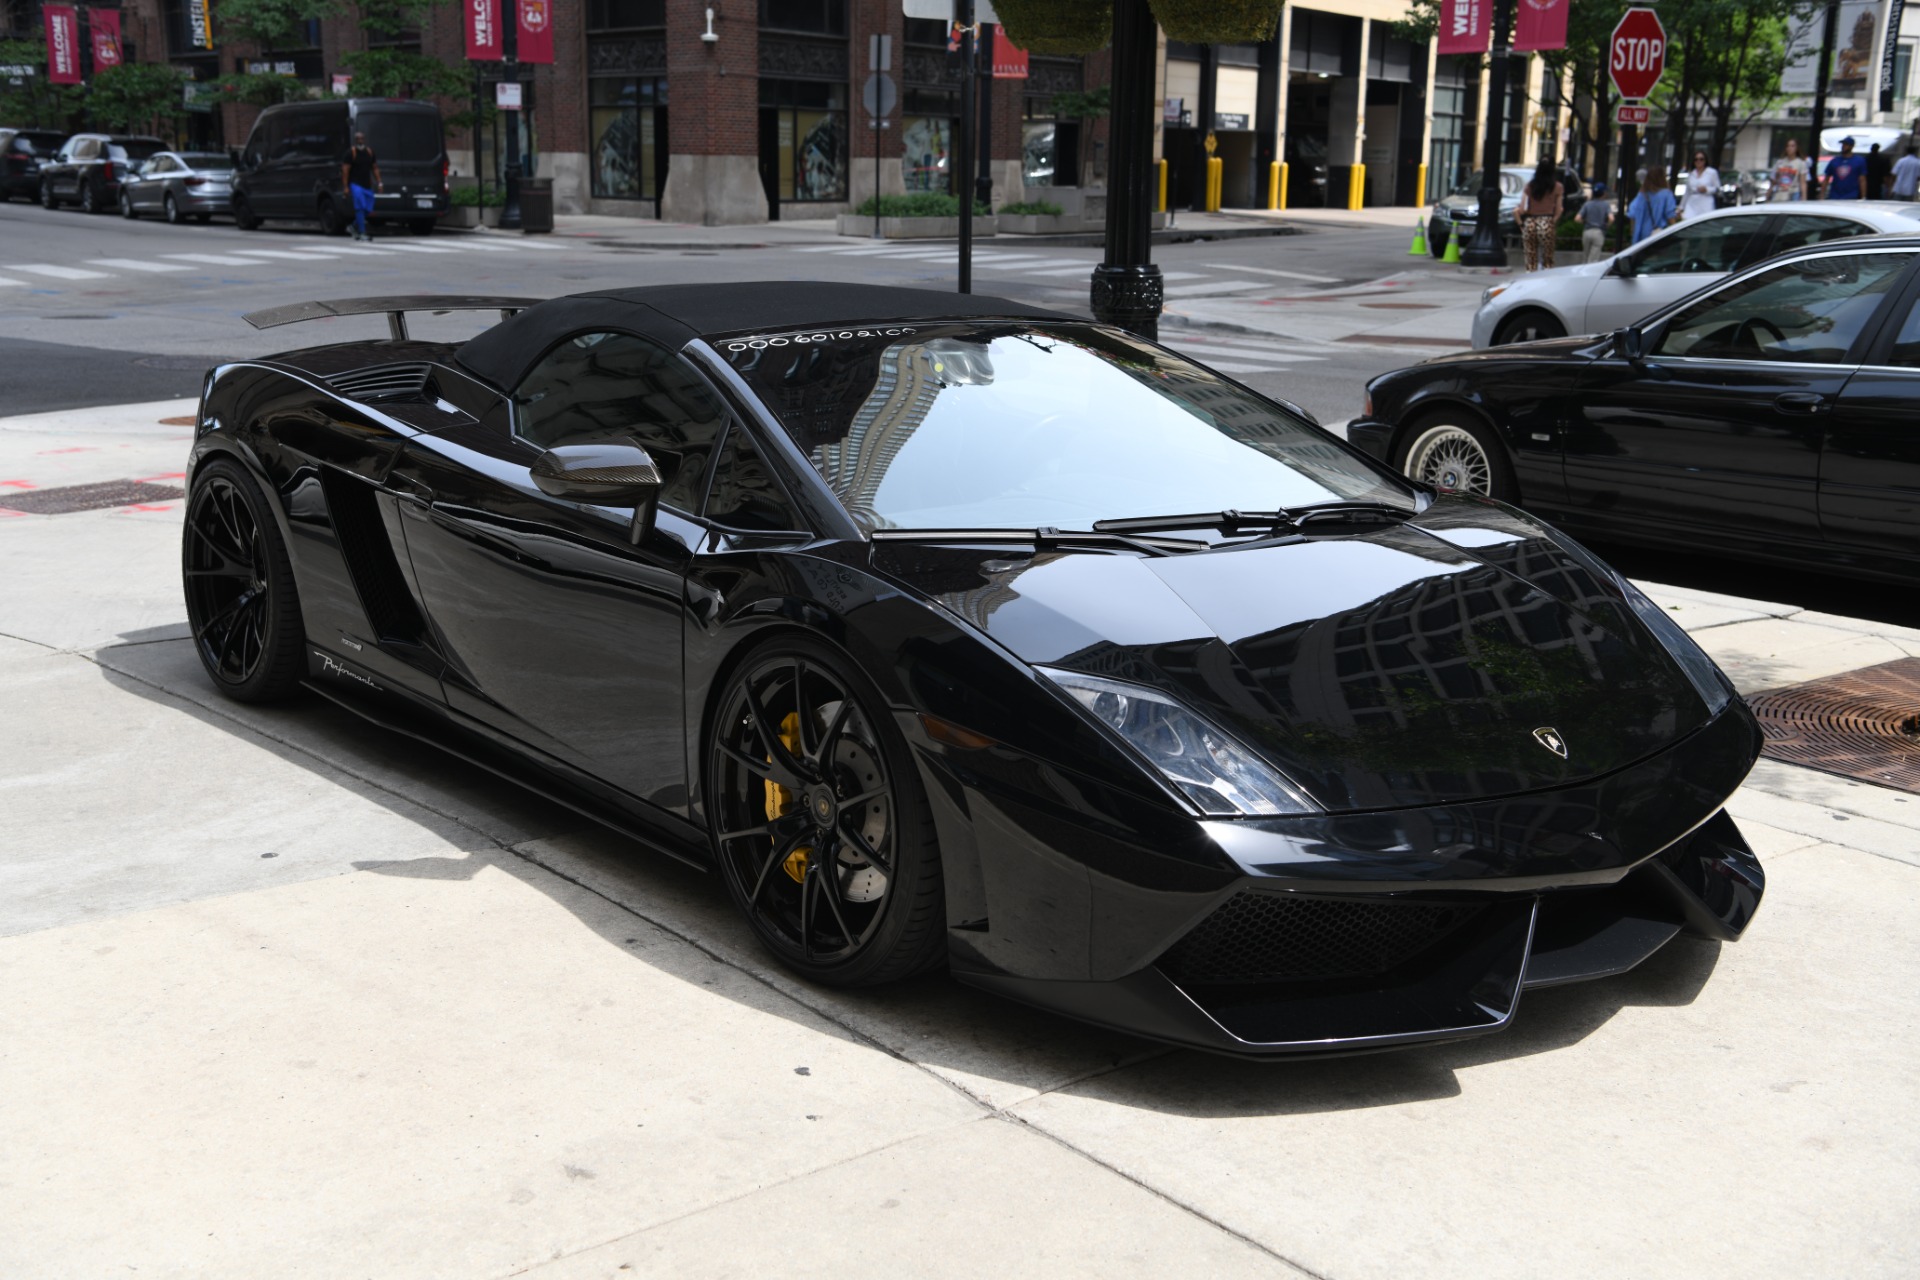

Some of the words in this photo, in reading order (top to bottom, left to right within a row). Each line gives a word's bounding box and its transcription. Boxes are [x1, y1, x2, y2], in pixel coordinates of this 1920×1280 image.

[474, 0, 487, 46] WELC
[1453, 0, 1469, 36] WE
[52, 15, 66, 74] WELCOME
[1614, 38, 1662, 71] STOP
[1881, 60, 1894, 92] rack
[1620, 108, 1632, 120] ALL
[1634, 109, 1647, 121] WAY
[314, 651, 383, 691] Performante
